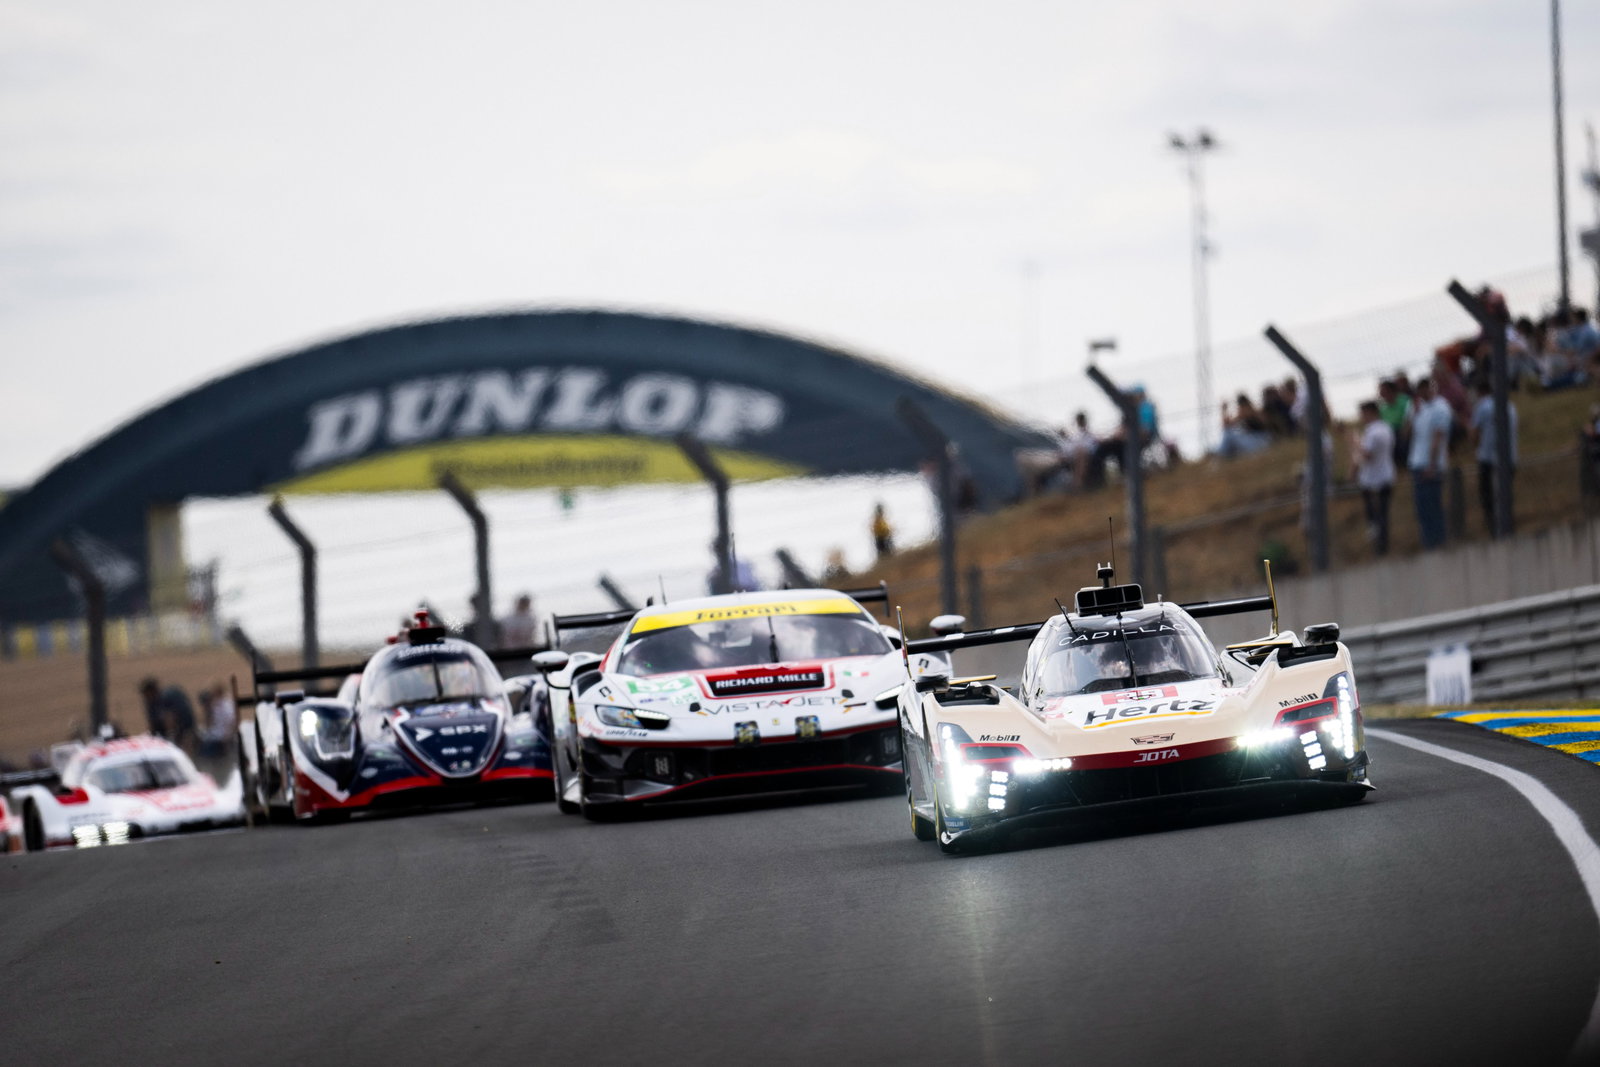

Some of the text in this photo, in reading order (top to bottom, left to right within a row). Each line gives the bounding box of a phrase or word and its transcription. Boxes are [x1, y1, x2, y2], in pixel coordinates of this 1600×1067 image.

[294, 367, 784, 470] DUNLOP
[1059, 623, 1187, 646] CADILLAC
[716, 672, 817, 688] RICHARD MILLE
[1083, 700, 1215, 725] Hertz
[1133, 749, 1180, 763] JOTA
